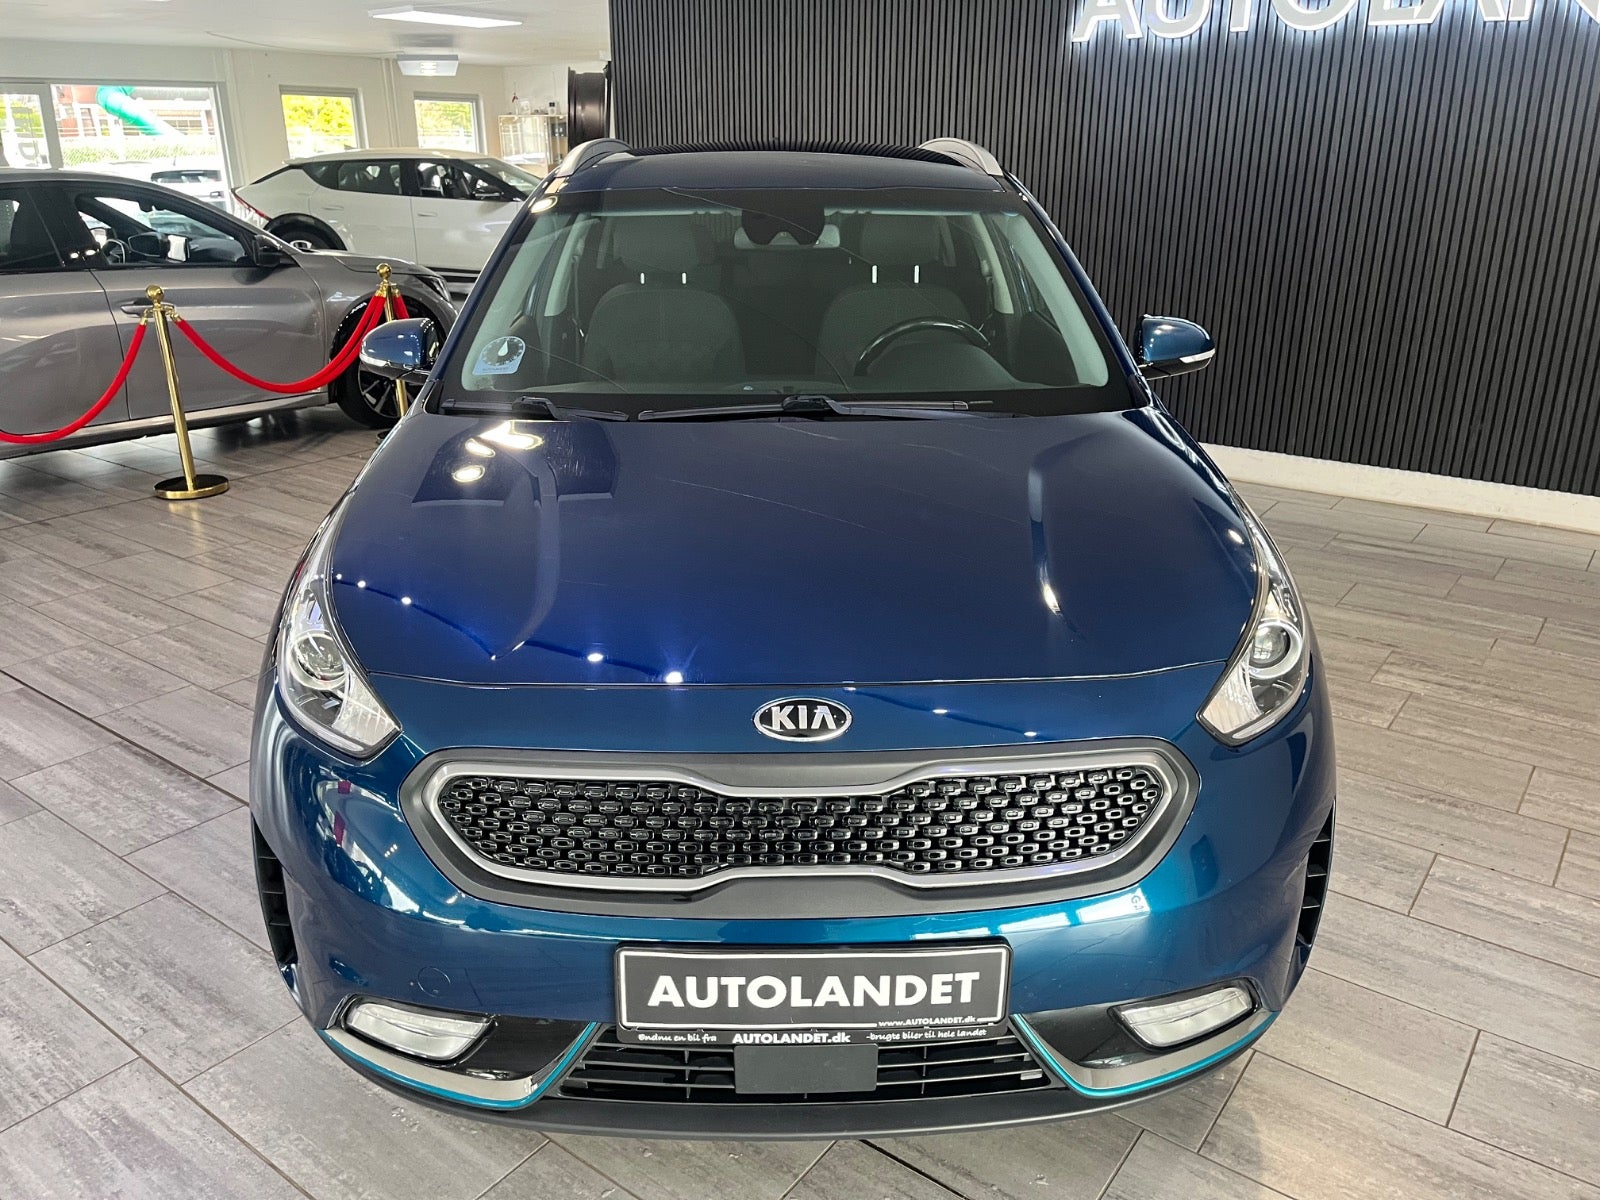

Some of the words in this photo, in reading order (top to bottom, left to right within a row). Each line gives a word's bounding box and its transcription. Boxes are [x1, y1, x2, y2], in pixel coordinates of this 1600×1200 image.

[771, 705, 837, 730] KIA
[648, 972, 980, 1008] AUTOLANDET
[878, 1016, 976, 1027] www.AUTOLANDET.dk
[673, 1034, 686, 1042] en
[687, 1033, 701, 1042] bil
[701, 1033, 717, 1044] fra
[732, 1032, 851, 1044] AUTOLANDET.dk
[902, 1031, 923, 1040] biler
[924, 1030, 936, 1038] til
[937, 1029, 955, 1038] hele
[956, 1028, 987, 1037] landet
